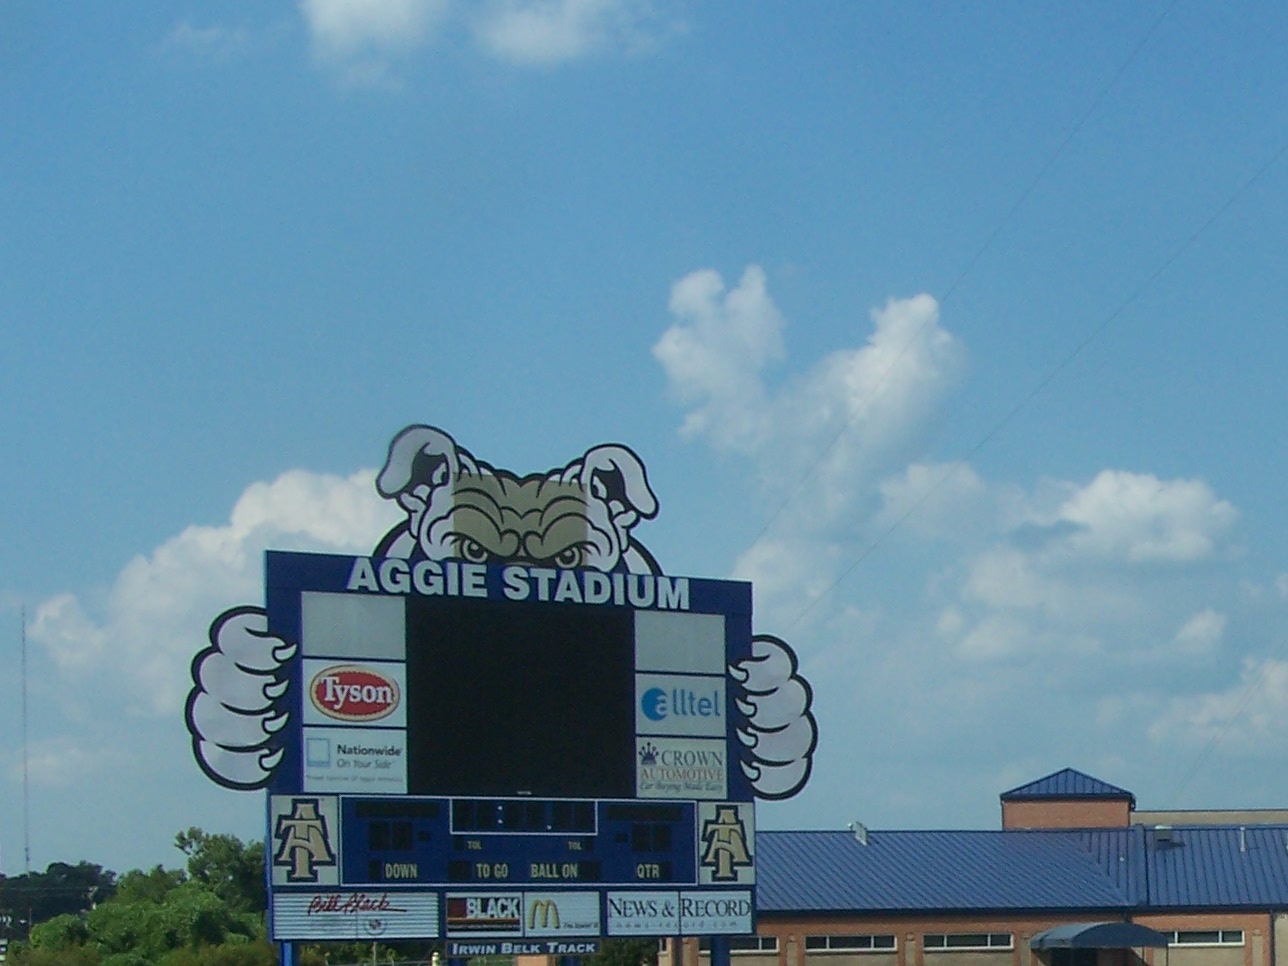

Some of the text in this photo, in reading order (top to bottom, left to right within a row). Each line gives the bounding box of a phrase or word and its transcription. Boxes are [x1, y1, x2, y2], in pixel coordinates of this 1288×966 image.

[347, 557, 690, 610] AGGIE STADIUM
[320, 676, 393, 710] Tyson
[337, 744, 402, 756] Nationwide
[661, 750, 723, 766] CROWN
[641, 768, 723, 780] AUTOMOTIVE
[385, 863, 418, 879] DOWN
[476, 863, 509, 879] TO GO
[530, 863, 578, 879] BALL ON
[636, 863, 660, 879] QTR
[466, 898, 519, 919] BLACK
[661, 900, 675, 918] &
[681, 898, 751, 918] RECORD
[452, 942, 596, 955] IRWIN BELK TRACK
